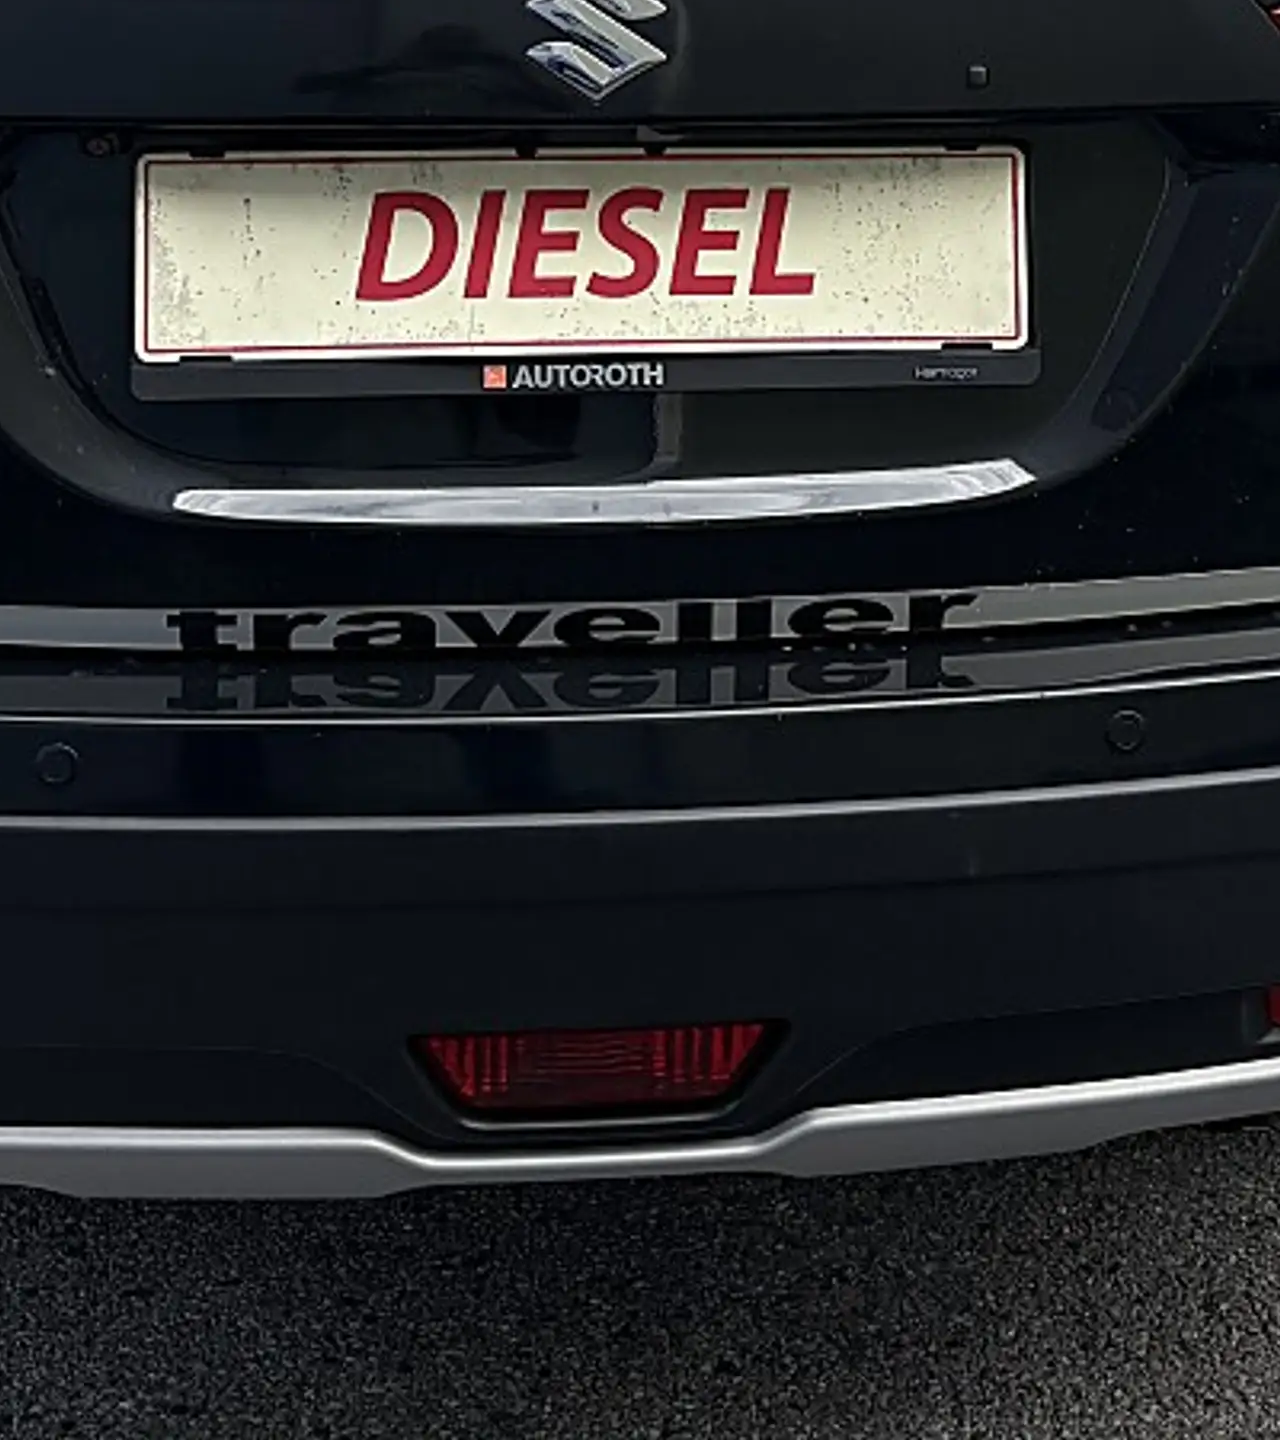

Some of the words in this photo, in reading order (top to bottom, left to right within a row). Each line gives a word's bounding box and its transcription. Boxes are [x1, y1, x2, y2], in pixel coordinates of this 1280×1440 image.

[355, 187, 816, 301] DIESEL
[511, 363, 664, 390] AUTOROTH
[166, 590, 980, 652] traveller
